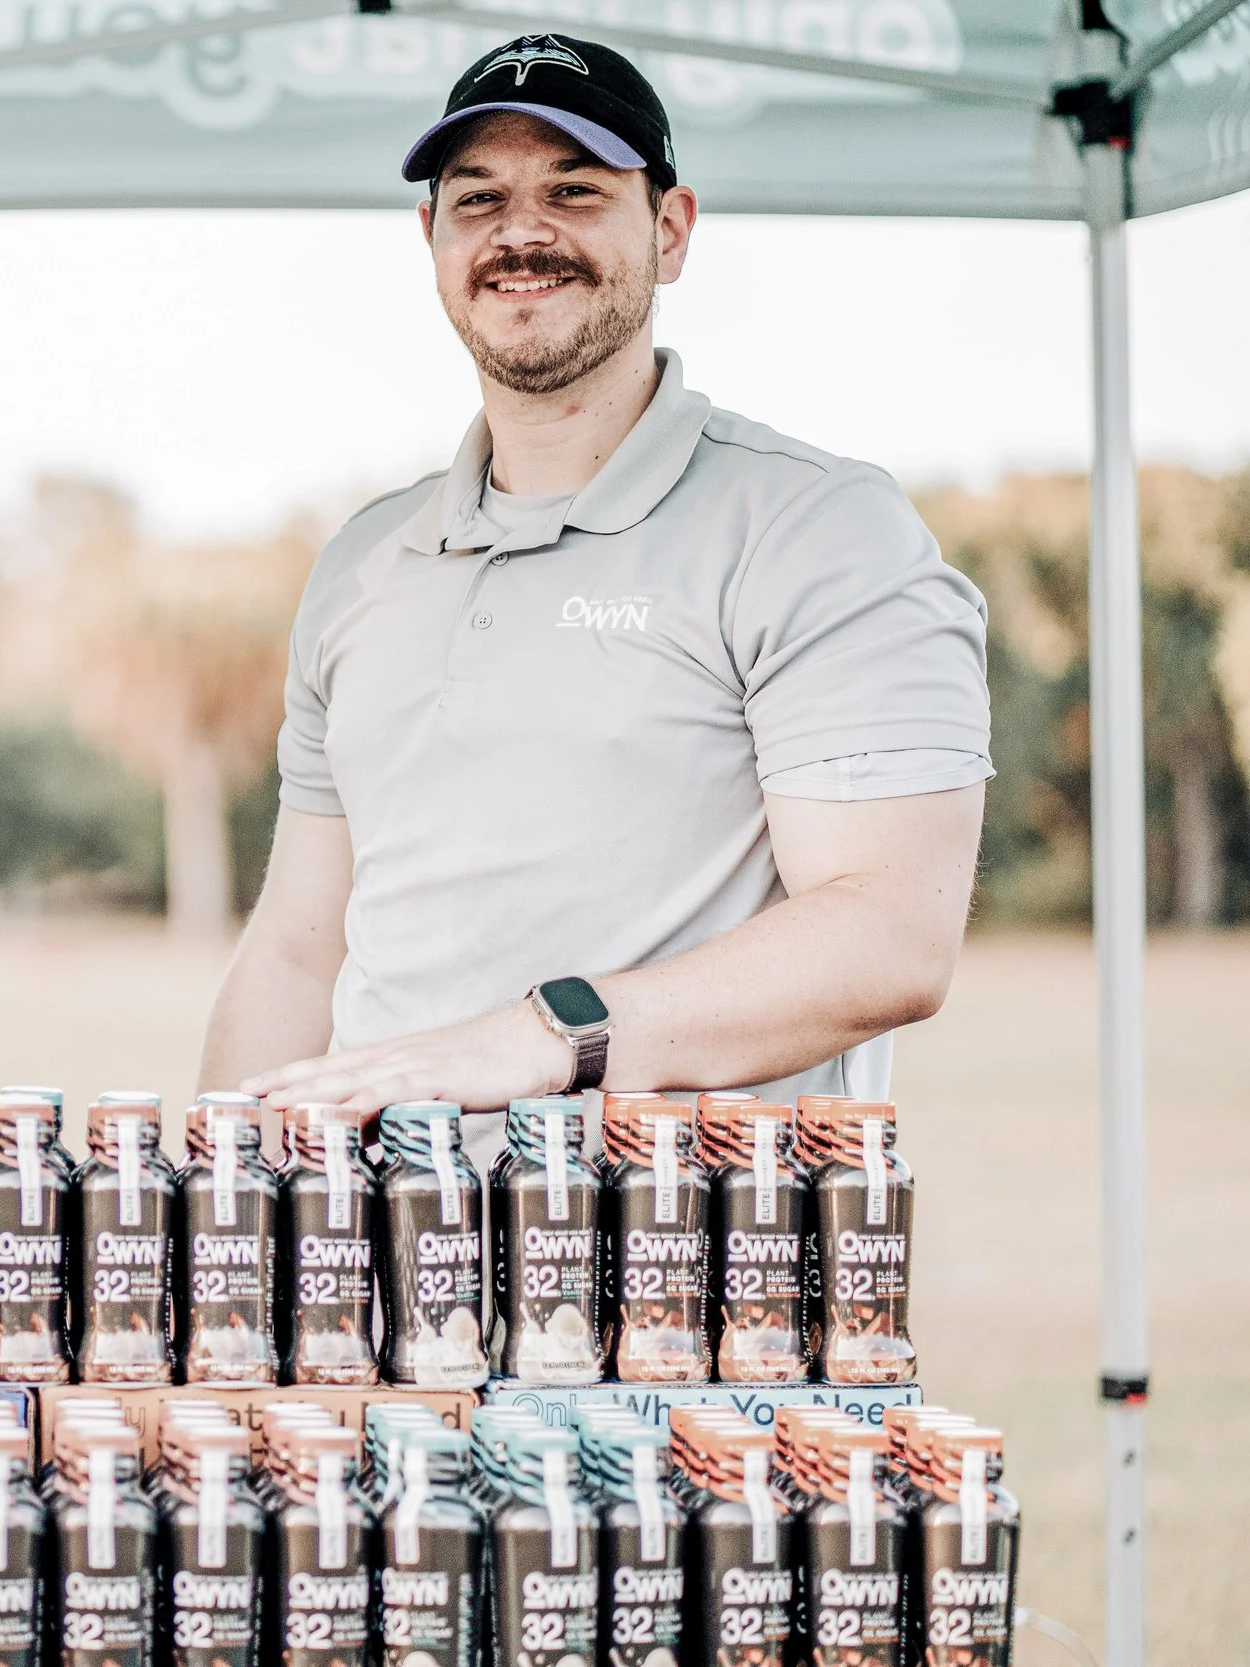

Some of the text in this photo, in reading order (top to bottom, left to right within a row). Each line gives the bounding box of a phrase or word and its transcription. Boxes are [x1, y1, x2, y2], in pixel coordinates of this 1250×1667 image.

[555, 596, 650, 631] OWYN
[662, 1192, 670, 1219] ELITE
[762, 1194, 770, 1220] ELITE
[873, 1194, 881, 1221] ELITE
[97, 1231, 163, 1265] OWYN
[194, 1232, 259, 1265] OWYN
[300, 1234, 371, 1268] OWYN
[418, 1231, 479, 1265] OWYN
[525, 1226, 591, 1259] OWYN
[627, 1228, 698, 1262] OWYN
[728, 1229, 798, 1263] OWYN
[839, 1229, 906, 1263] OWYN
[65, 1572, 141, 1610] OWYN
[173, 1570, 250, 1609] OWYN
[288, 1572, 369, 1609] OWYN
[382, 1567, 449, 1606] OWYN
[523, 1571, 598, 1609] OWYN
[614, 1567, 684, 1602] OWYN
[722, 1567, 793, 1605] OWYN
[820, 1569, 900, 1606] OWYN
[932, 1568, 1008, 1606] OWYN
